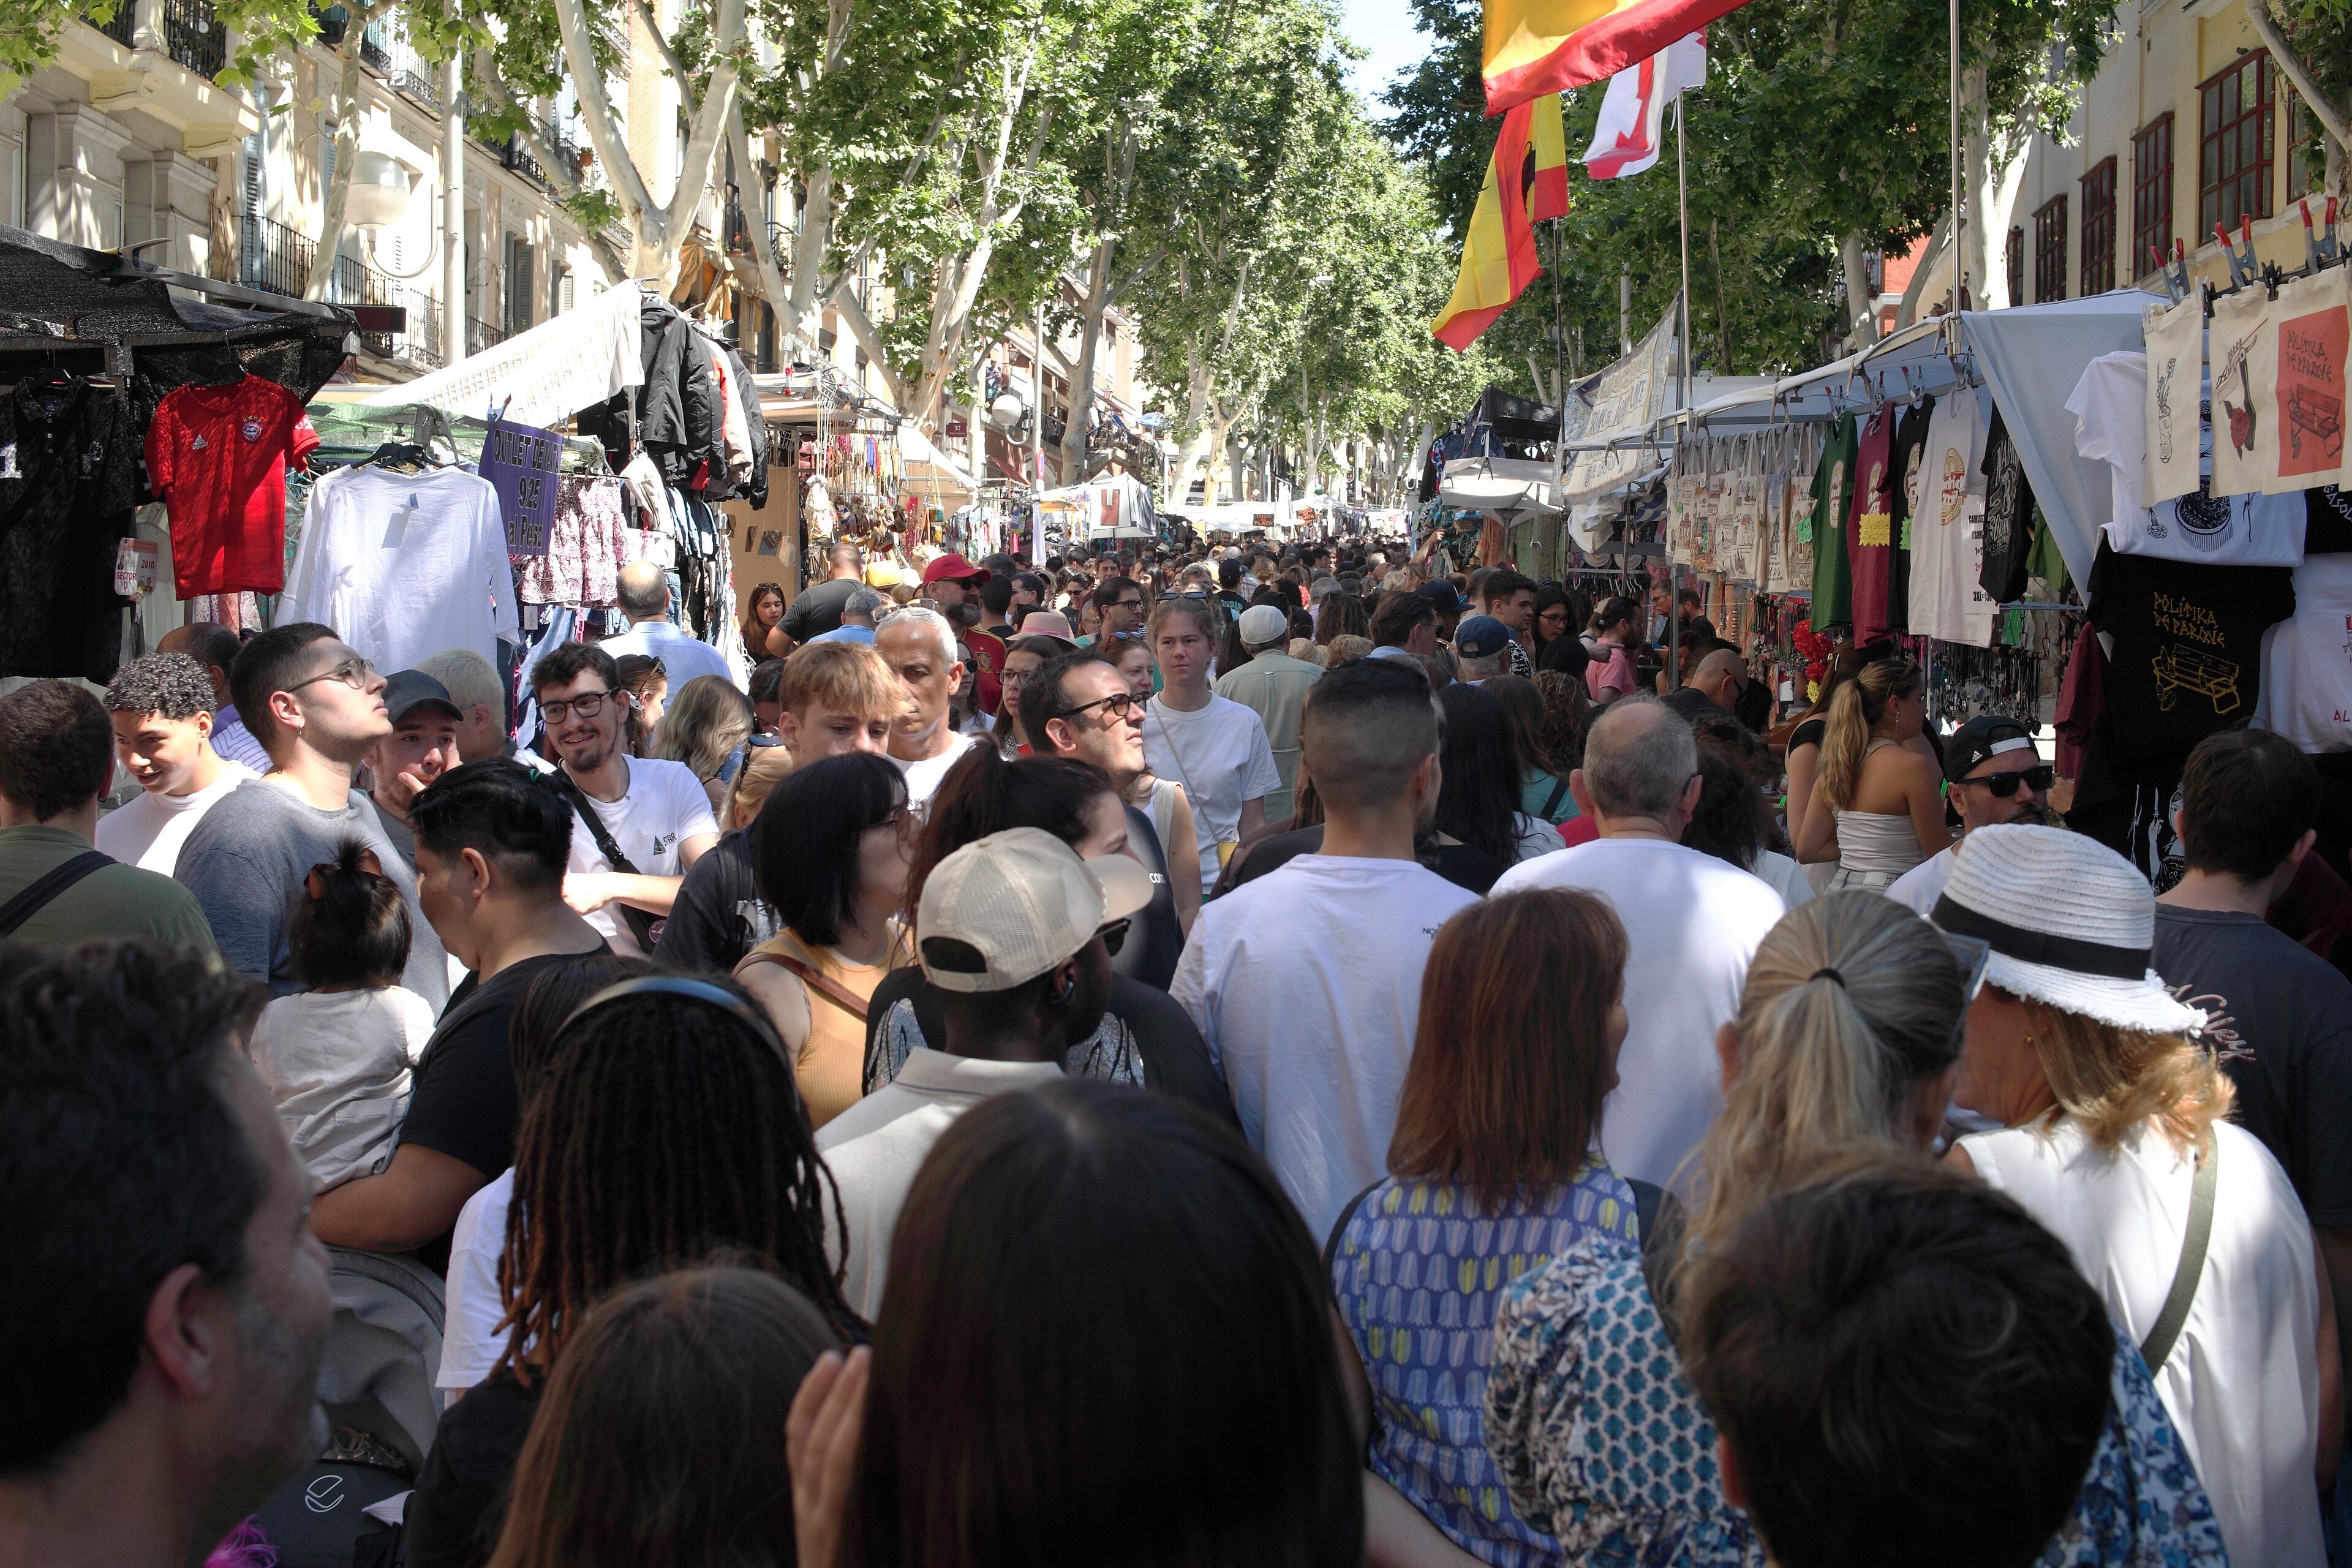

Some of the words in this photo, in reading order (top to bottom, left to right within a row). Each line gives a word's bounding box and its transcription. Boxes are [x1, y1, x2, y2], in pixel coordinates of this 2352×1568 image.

[494, 428, 532, 468] OUTLET
[532, 437, 545, 472] DE
[518, 475, 541, 510] 925
[2323, 484, 2352, 522] GASOL
[508, 514, 518, 546] al
[519, 514, 543, 549] Peso
[116, 571, 137, 581] SECTOR
[141, 559, 154, 570] 2010
[123, 581, 128, 590] D
